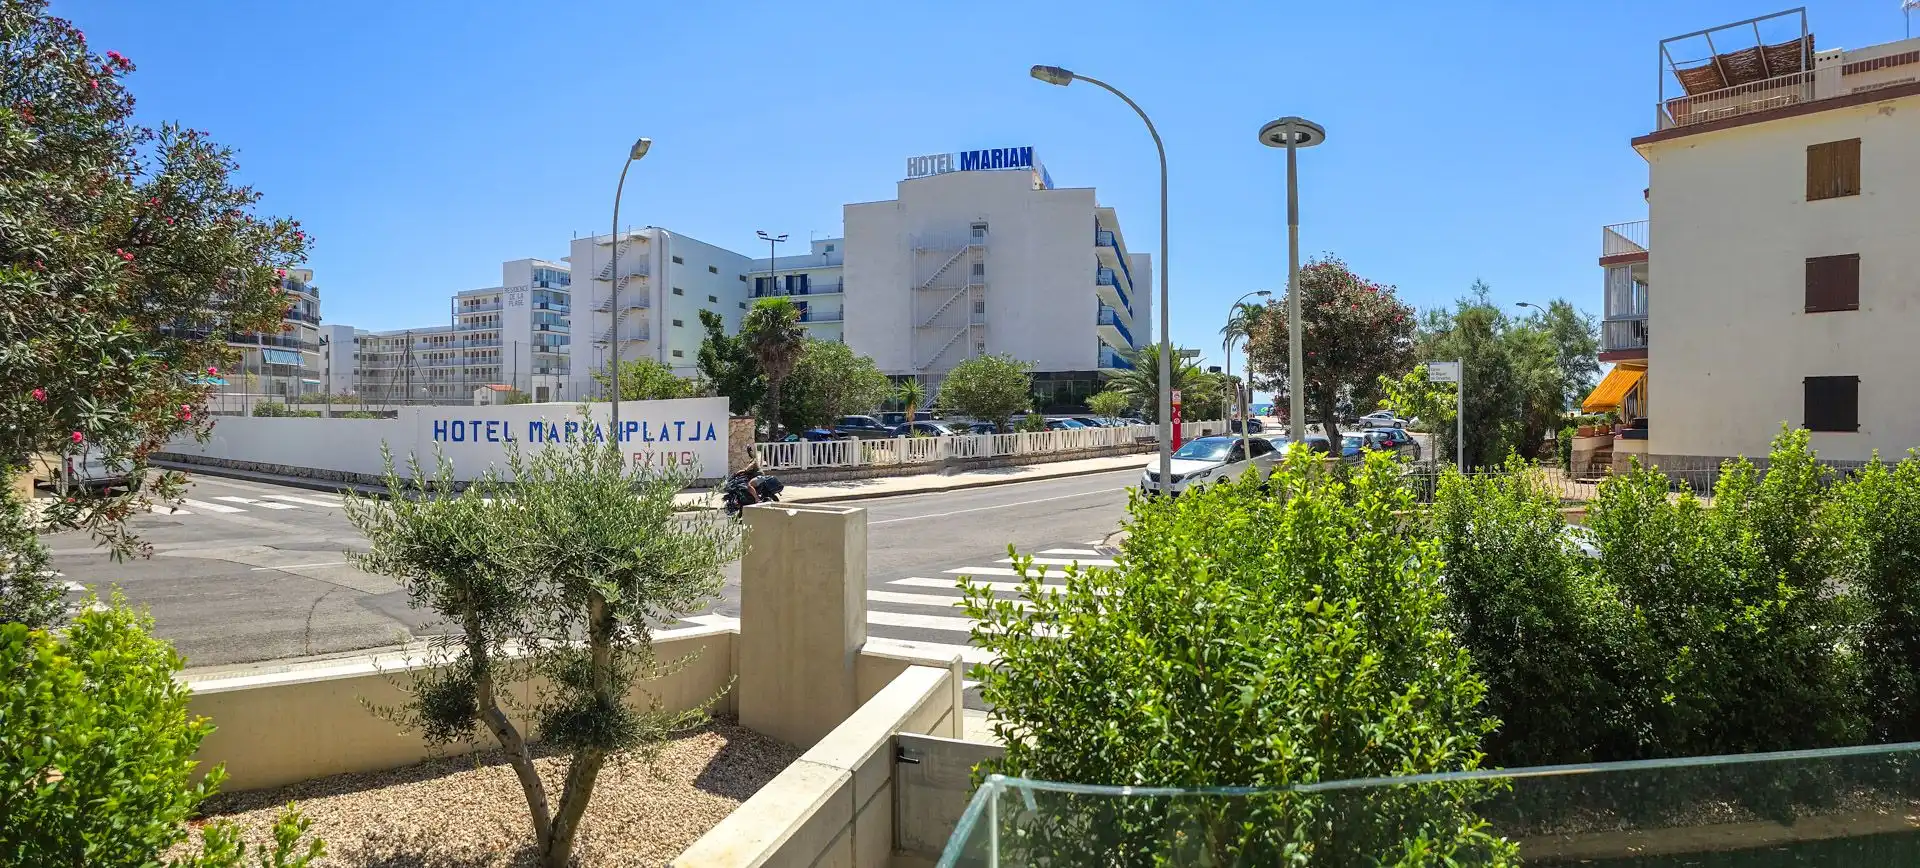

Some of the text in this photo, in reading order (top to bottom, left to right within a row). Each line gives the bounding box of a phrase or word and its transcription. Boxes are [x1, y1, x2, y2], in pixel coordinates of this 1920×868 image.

[907, 146, 1032, 177] HOTEL MARIAN
[433, 420, 514, 442] HOTEL
[625, 421, 717, 442] PLATJA
